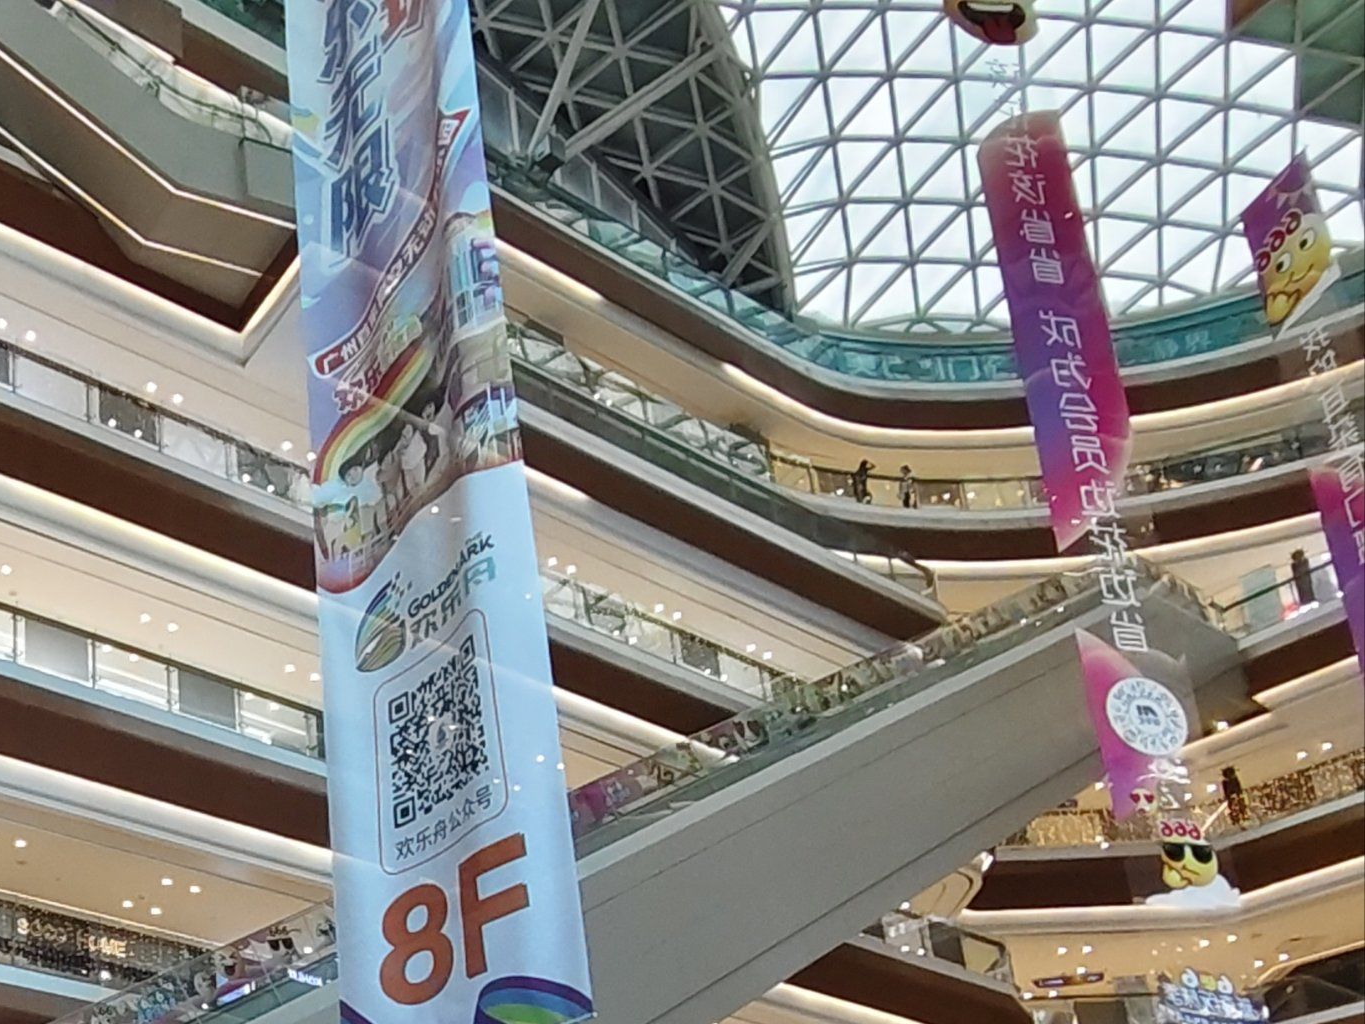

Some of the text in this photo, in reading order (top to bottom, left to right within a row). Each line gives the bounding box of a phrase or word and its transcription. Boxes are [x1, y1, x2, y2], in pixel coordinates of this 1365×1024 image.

[395, 784, 493, 861] 欢乐舟公众号
[379, 832, 530, 1006] 8F
